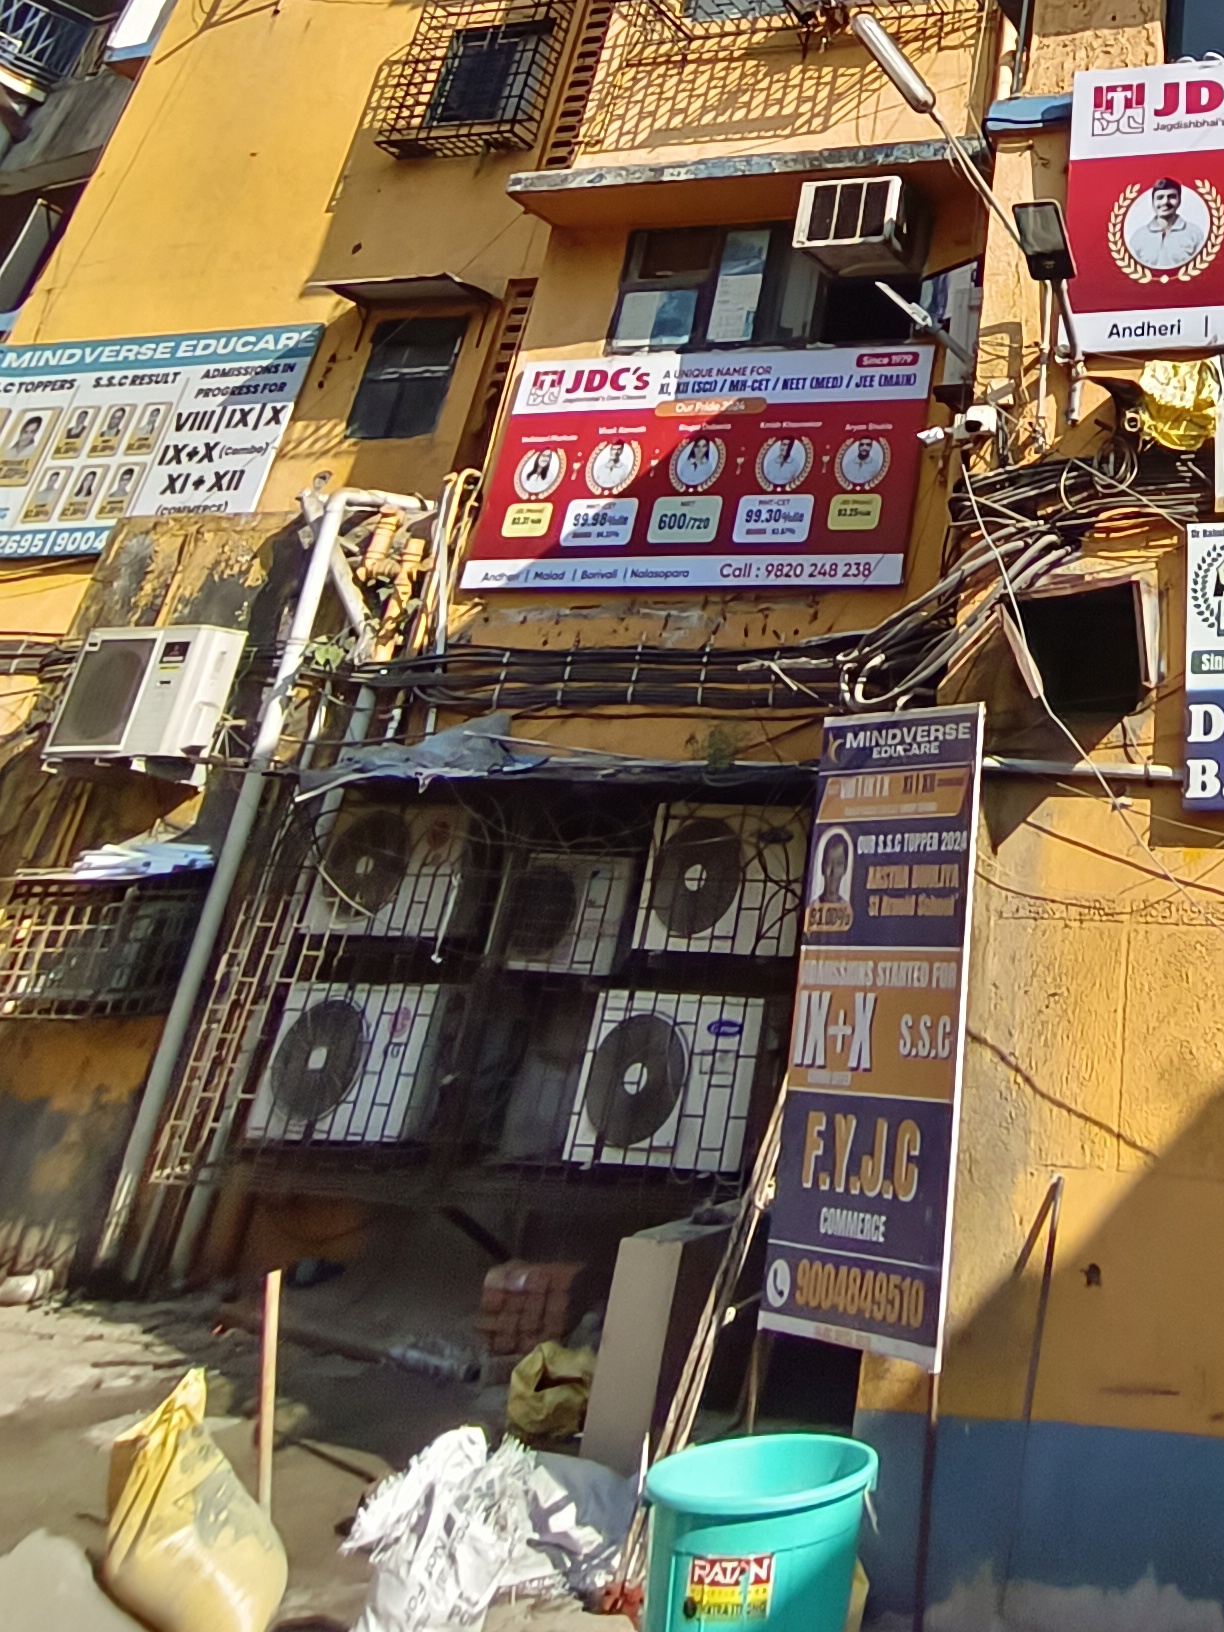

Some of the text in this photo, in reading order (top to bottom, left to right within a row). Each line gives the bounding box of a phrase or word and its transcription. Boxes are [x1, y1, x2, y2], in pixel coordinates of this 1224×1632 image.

[1107, 318, 1182, 339] Andheri
[1, 329, 320, 369] MINDVERSE EDUCARE
[129, 371, 182, 386] RESULT
[200, 362, 297, 380] ADMISSIONS IN
[565, 366, 651, 394] JDC's
[673, 366, 773, 379] UNIQUE NAME FOR
[17, 377, 78, 394] TOPPERS
[194, 381, 288, 399] PROGRESS FOR
[782, 377, 808, 391] NEET
[855, 374, 875, 388] JEE
[719, 561, 872, 579] Call 9820 248 238
[844, 721, 972, 750] MINDVERSE
[871, 741, 940, 759] EDUCARE
[793, 990, 878, 1071] IX+X
[801, 1110, 922, 1202] F.Y.J.C
[819, 1206, 887, 1243] COMMERCE
[794, 1258, 925, 1330] 9004849510
[692, 1557, 771, 1585] RATAN
